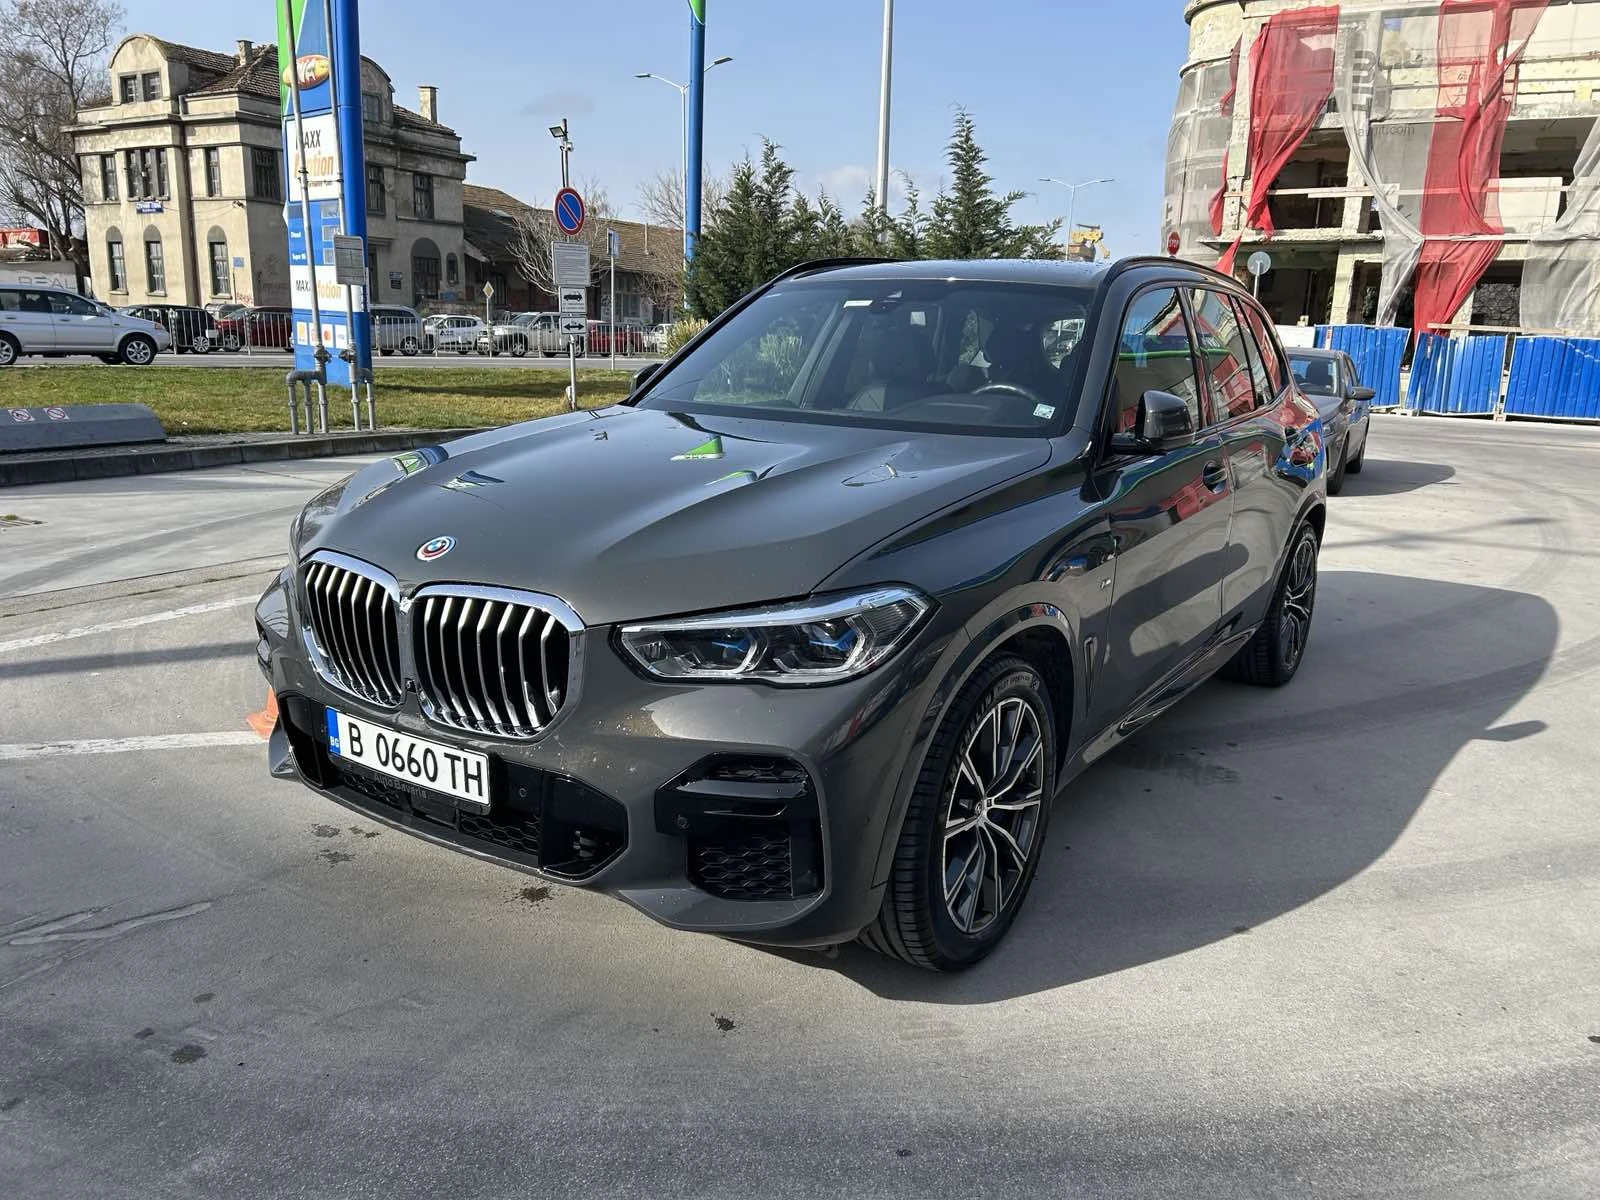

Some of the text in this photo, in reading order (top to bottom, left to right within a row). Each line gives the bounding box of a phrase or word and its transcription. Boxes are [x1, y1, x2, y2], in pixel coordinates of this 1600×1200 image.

[330, 735, 340, 748] BG
[348, 721, 483, 797] B 0660 TH
